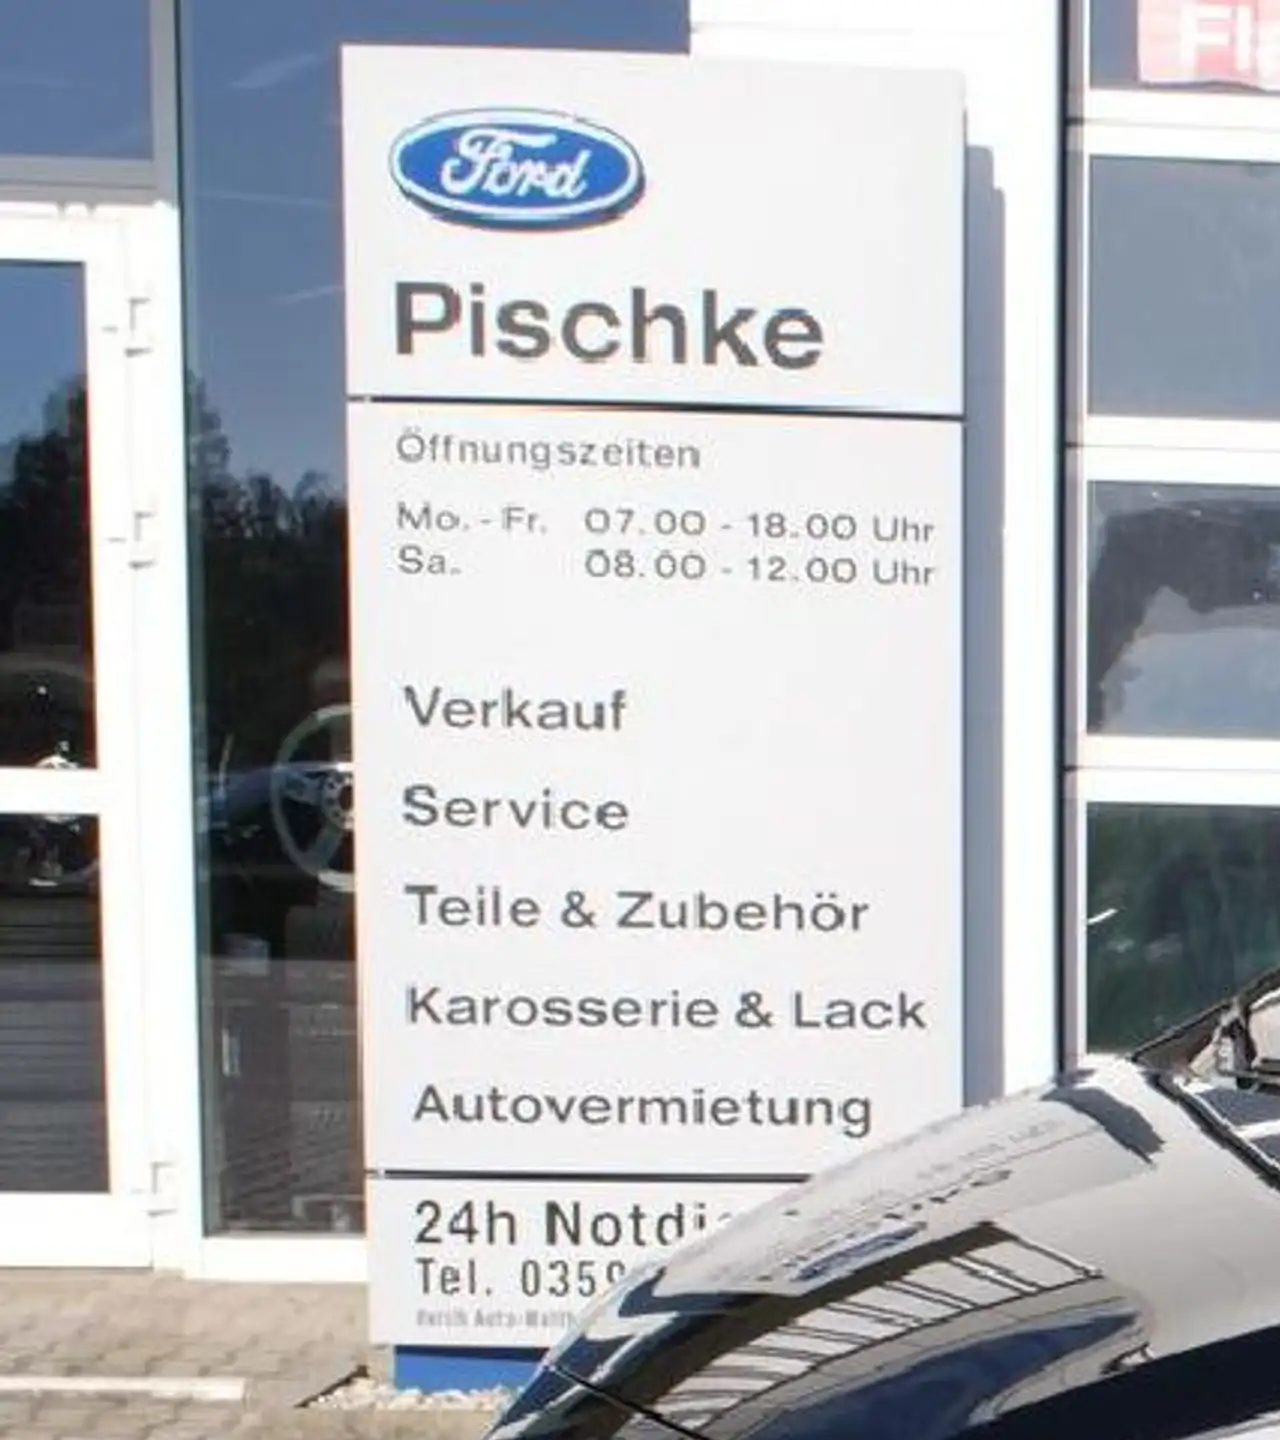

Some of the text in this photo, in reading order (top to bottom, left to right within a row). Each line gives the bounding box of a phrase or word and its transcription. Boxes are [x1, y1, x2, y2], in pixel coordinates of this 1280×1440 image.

[441, 127, 588, 199] Ford
[394, 281, 824, 370] Pischke
[396, 427, 702, 471] Öffnungszeiten
[584, 507, 707, 536] 07.00
[748, 512, 858, 541] 18.00
[872, 515, 935, 543] Uhr
[398, 544, 463, 575] Sa.
[584, 548, 707, 580] 08.00
[747, 554, 858, 585] 12.00
[872, 559, 935, 586] Uhr
[403, 684, 628, 731] Verkauf
[402, 783, 630, 831] Service
[403, 883, 870, 933] Teile & Zubehör
[406, 986, 928, 1030] Karosserie & Lack
[413, 1084, 872, 1139] Autovermietung
[414, 1199, 518, 1246] 24h
[414, 1256, 493, 1297] Tel.
